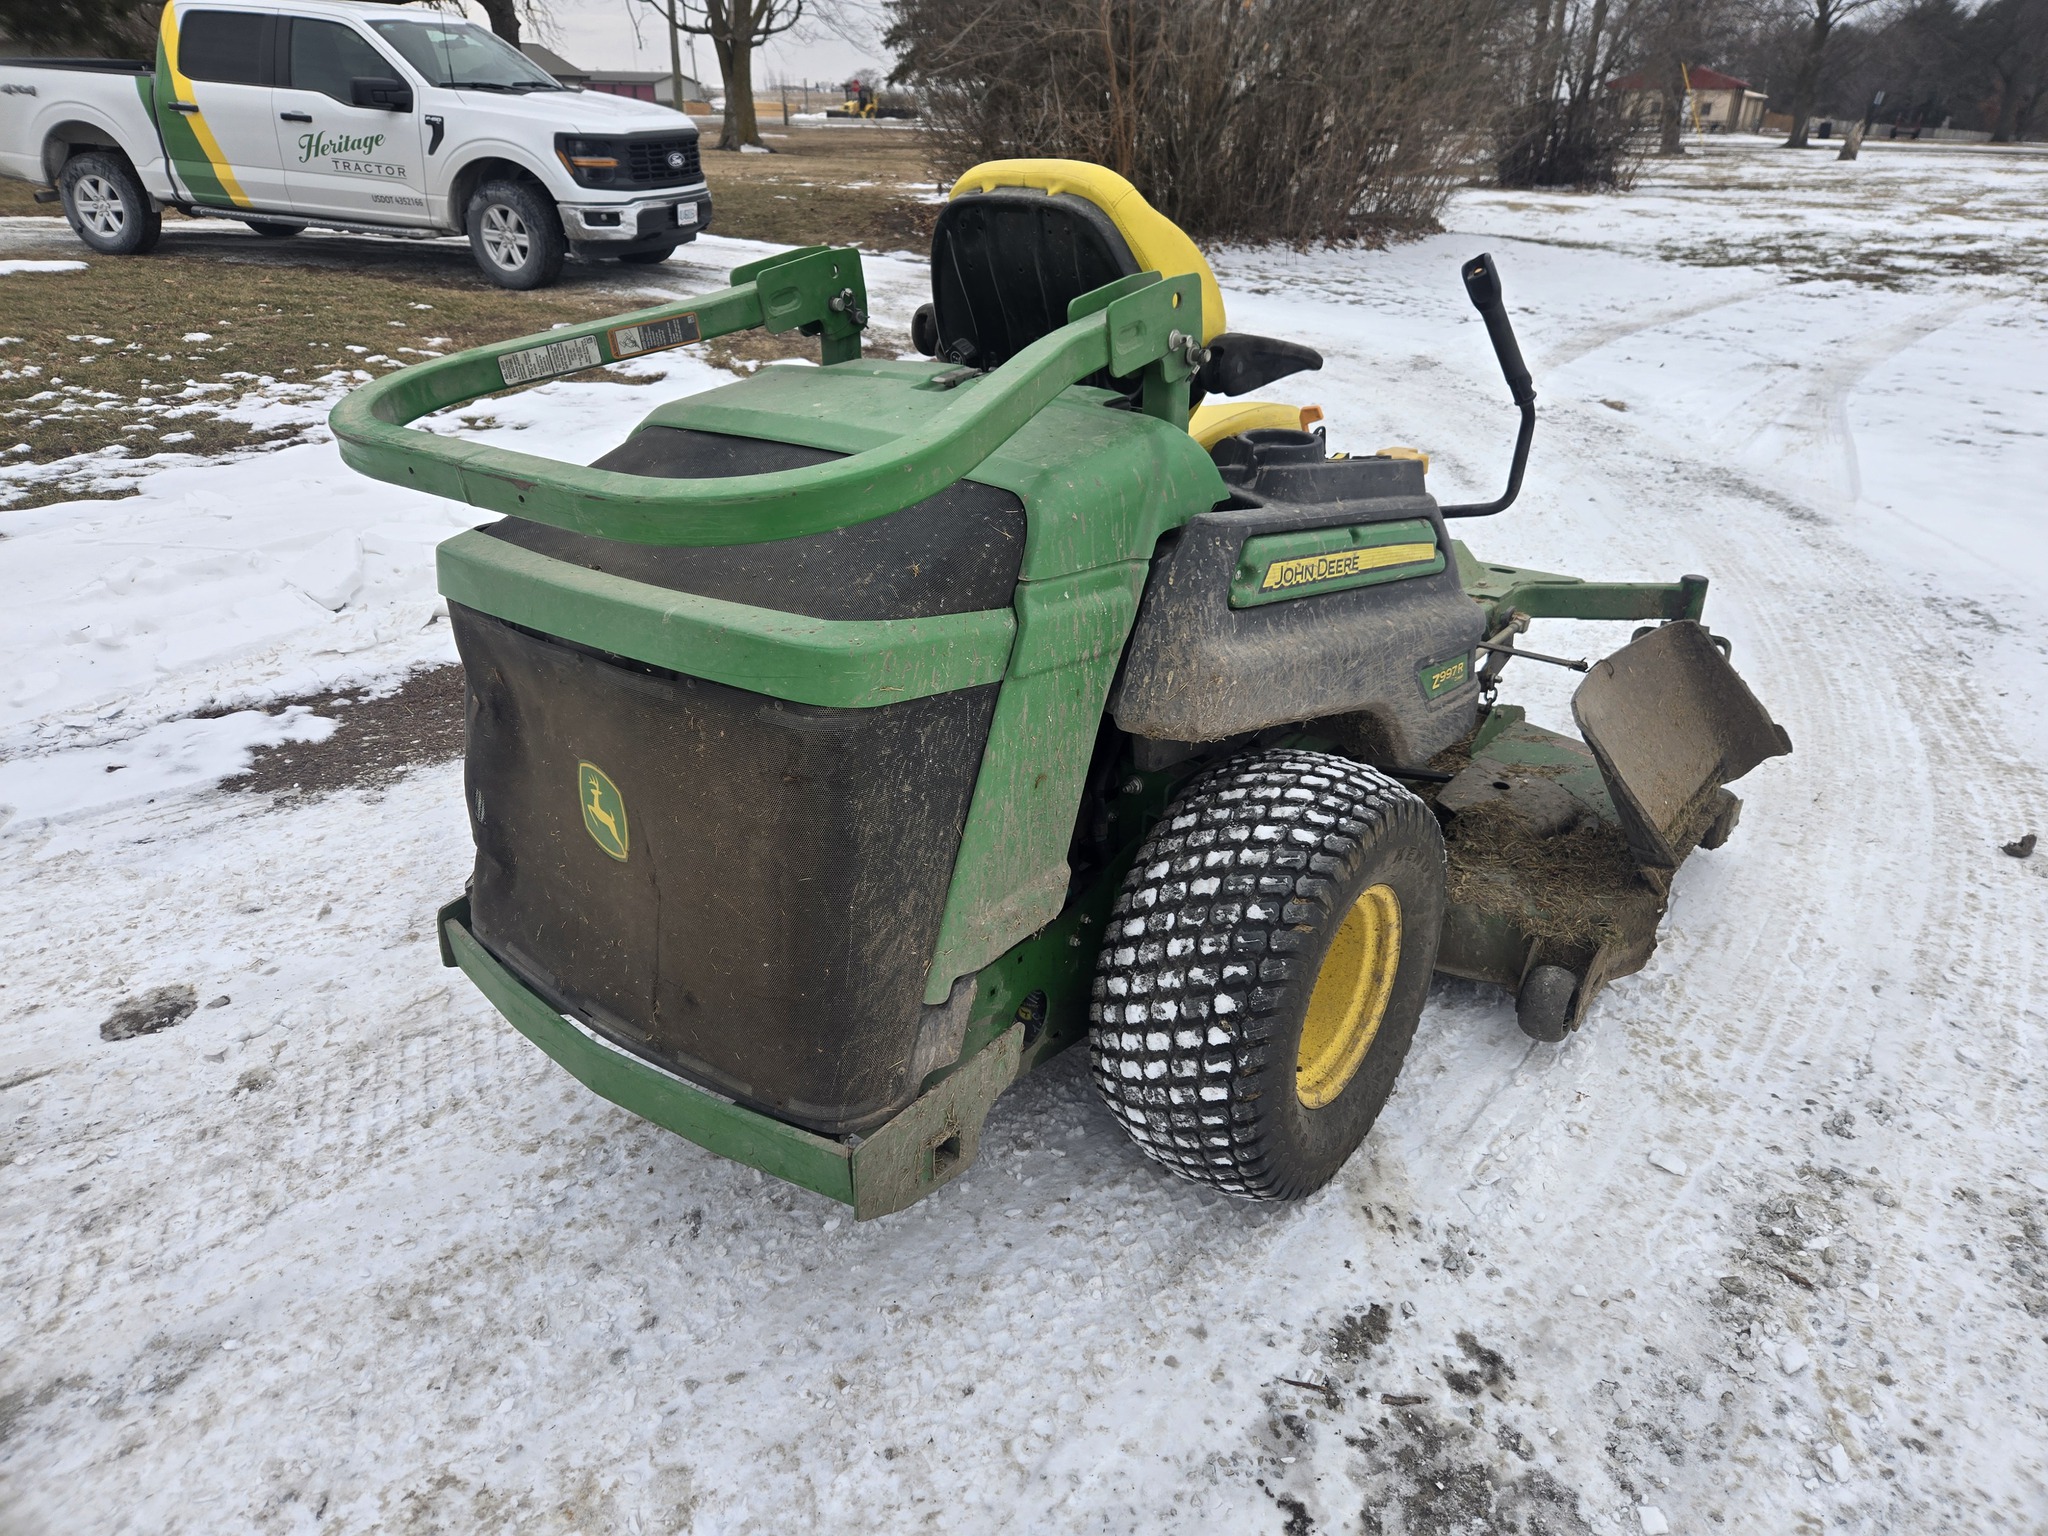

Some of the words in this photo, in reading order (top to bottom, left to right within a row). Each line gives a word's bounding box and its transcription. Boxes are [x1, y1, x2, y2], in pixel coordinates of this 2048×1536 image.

[298, 130, 386, 163] Heritage
[331, 159, 407, 177] TRACTOR
[371, 194, 394, 204] USDOT
[1274, 563, 1315, 586] JOHN
[1317, 556, 1359, 578] DEERE
[1432, 662, 1464, 690] Z997R
